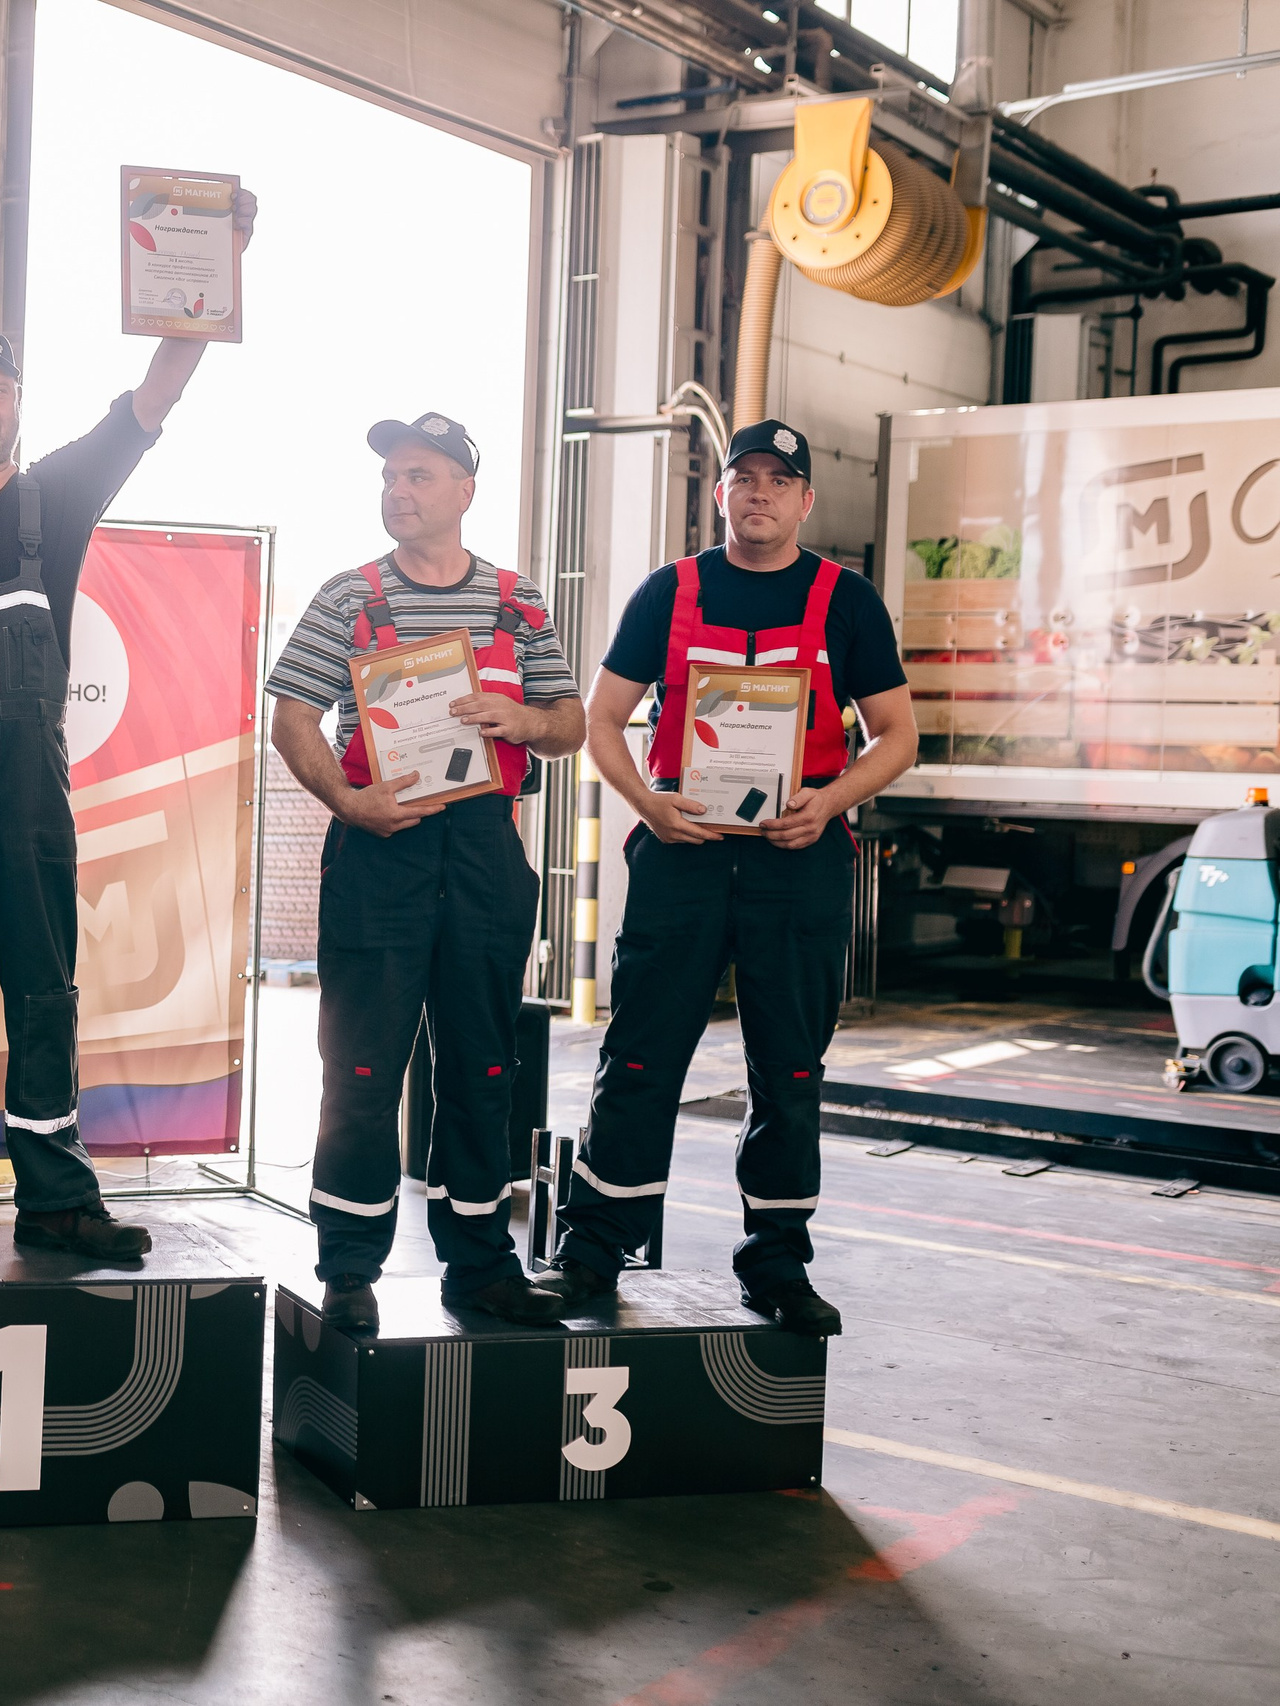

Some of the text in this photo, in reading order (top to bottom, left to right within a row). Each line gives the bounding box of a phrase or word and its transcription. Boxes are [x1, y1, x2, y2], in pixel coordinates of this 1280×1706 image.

[184, 188, 222, 199] МАГНИТ
[154, 224, 208, 236] Награждается
[416, 649, 453, 665] МАГНИТ
[752, 684, 790, 693] МАГНИТ
[393, 690, 447, 708] Награждается
[719, 721, 772, 730] Награждается
[560, 1365, 632, 1472] 3
